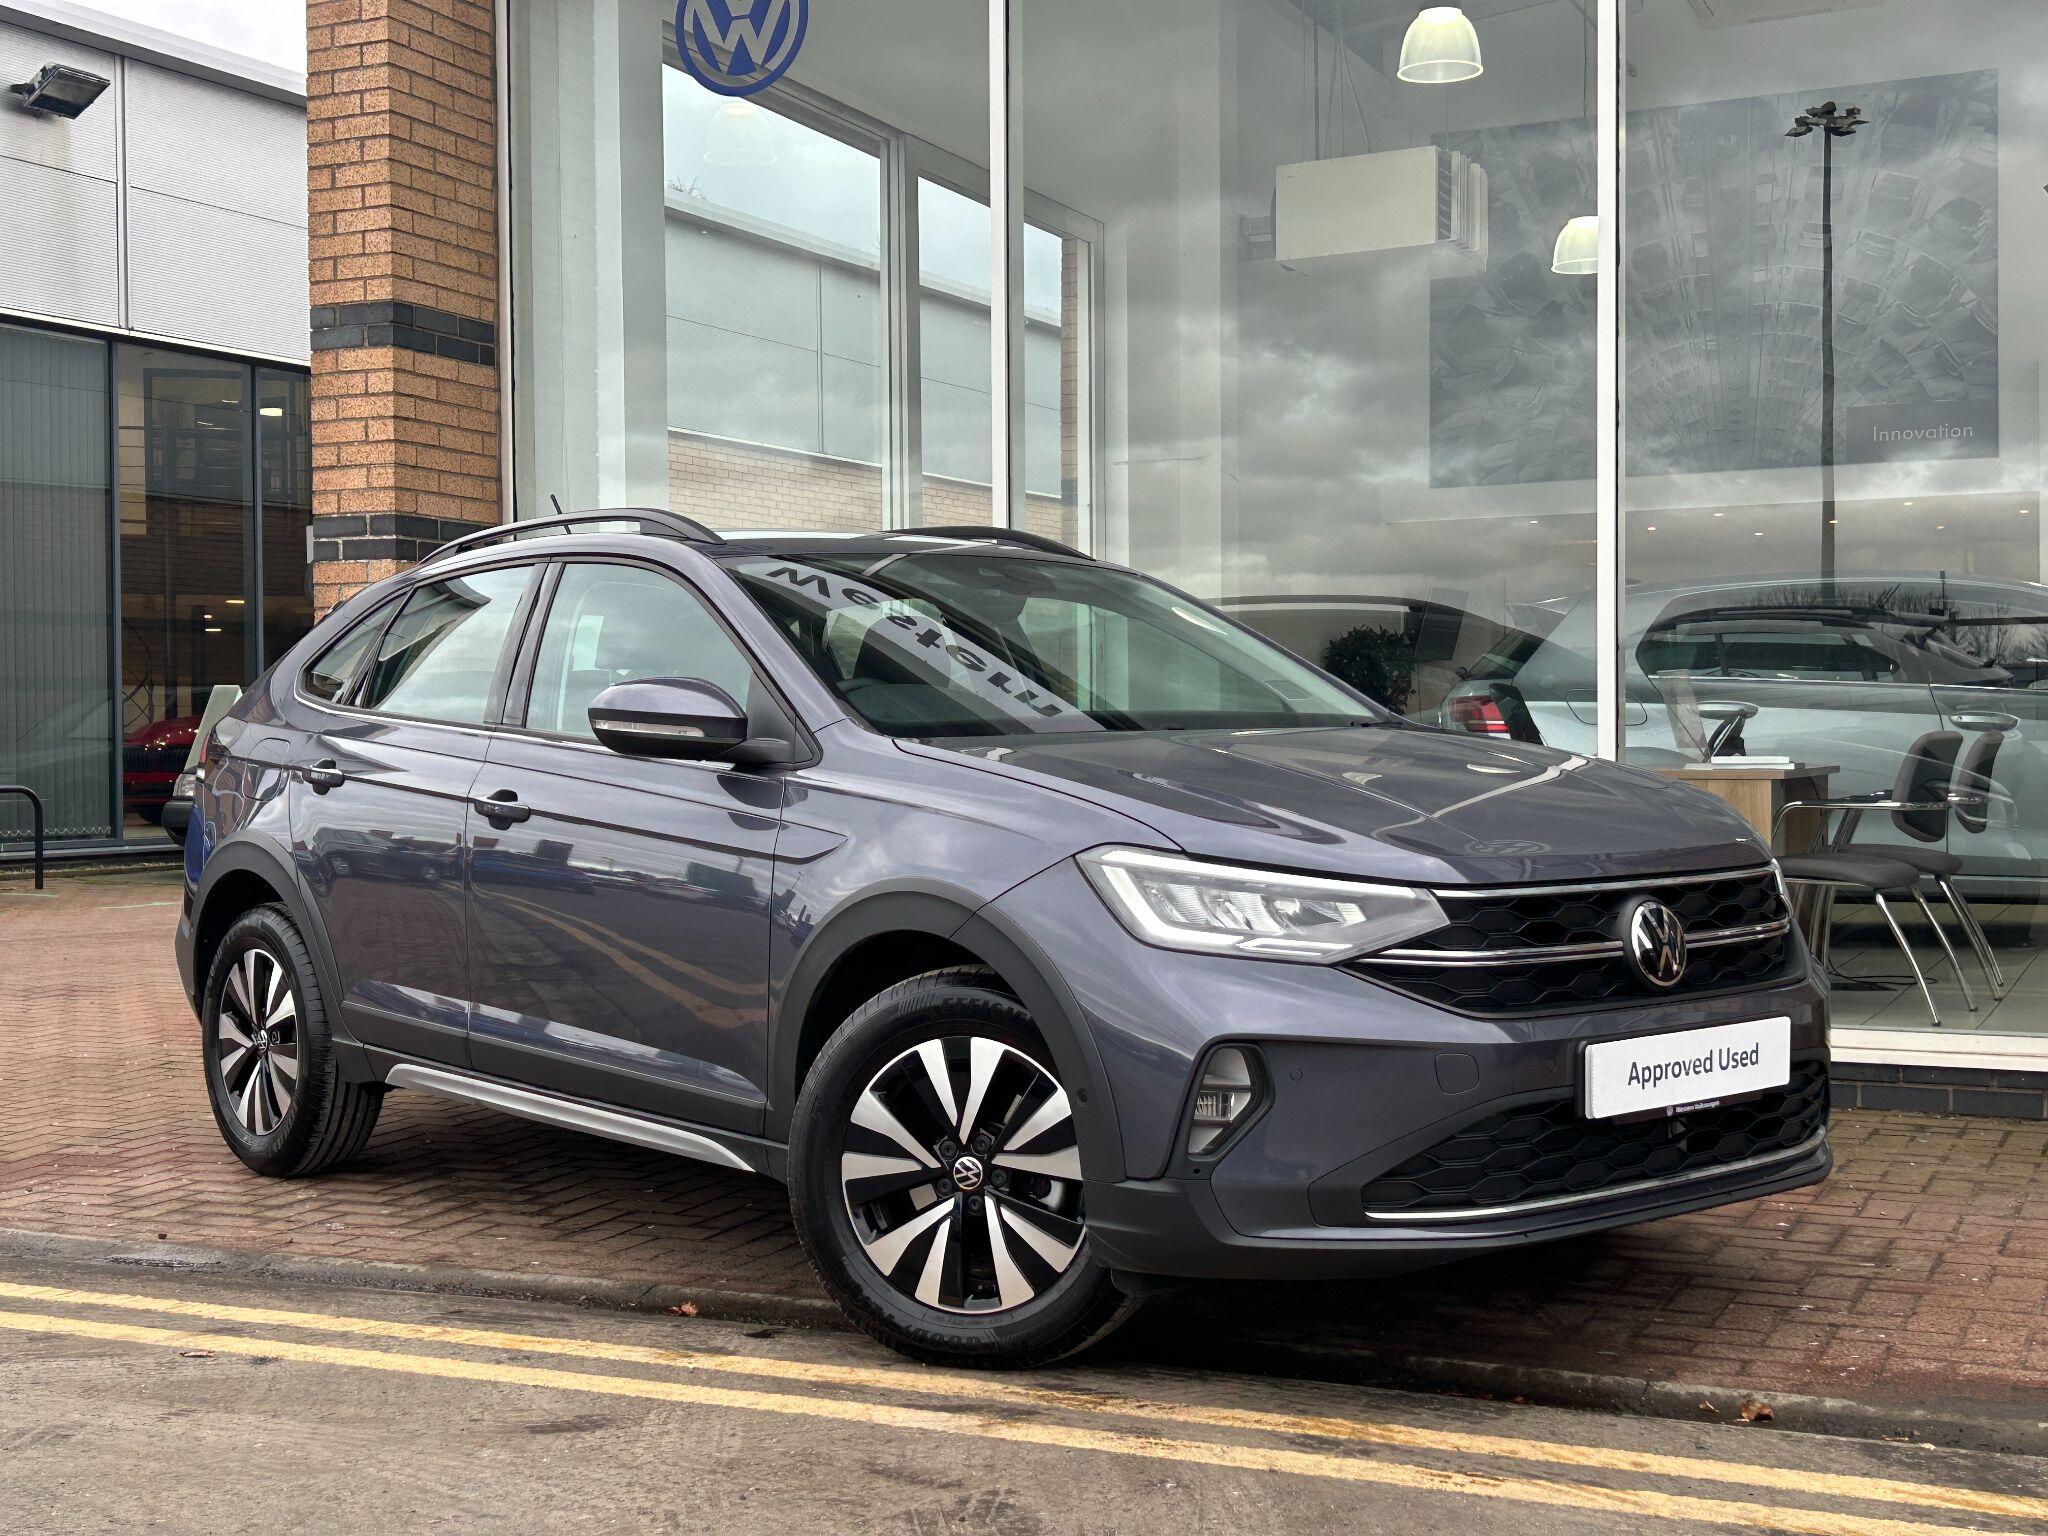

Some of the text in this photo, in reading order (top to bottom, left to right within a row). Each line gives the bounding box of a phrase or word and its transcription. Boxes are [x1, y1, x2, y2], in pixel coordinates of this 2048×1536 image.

[1873, 423, 1973, 441] Innovation
[1628, 1042, 1759, 1089] Approved Used
